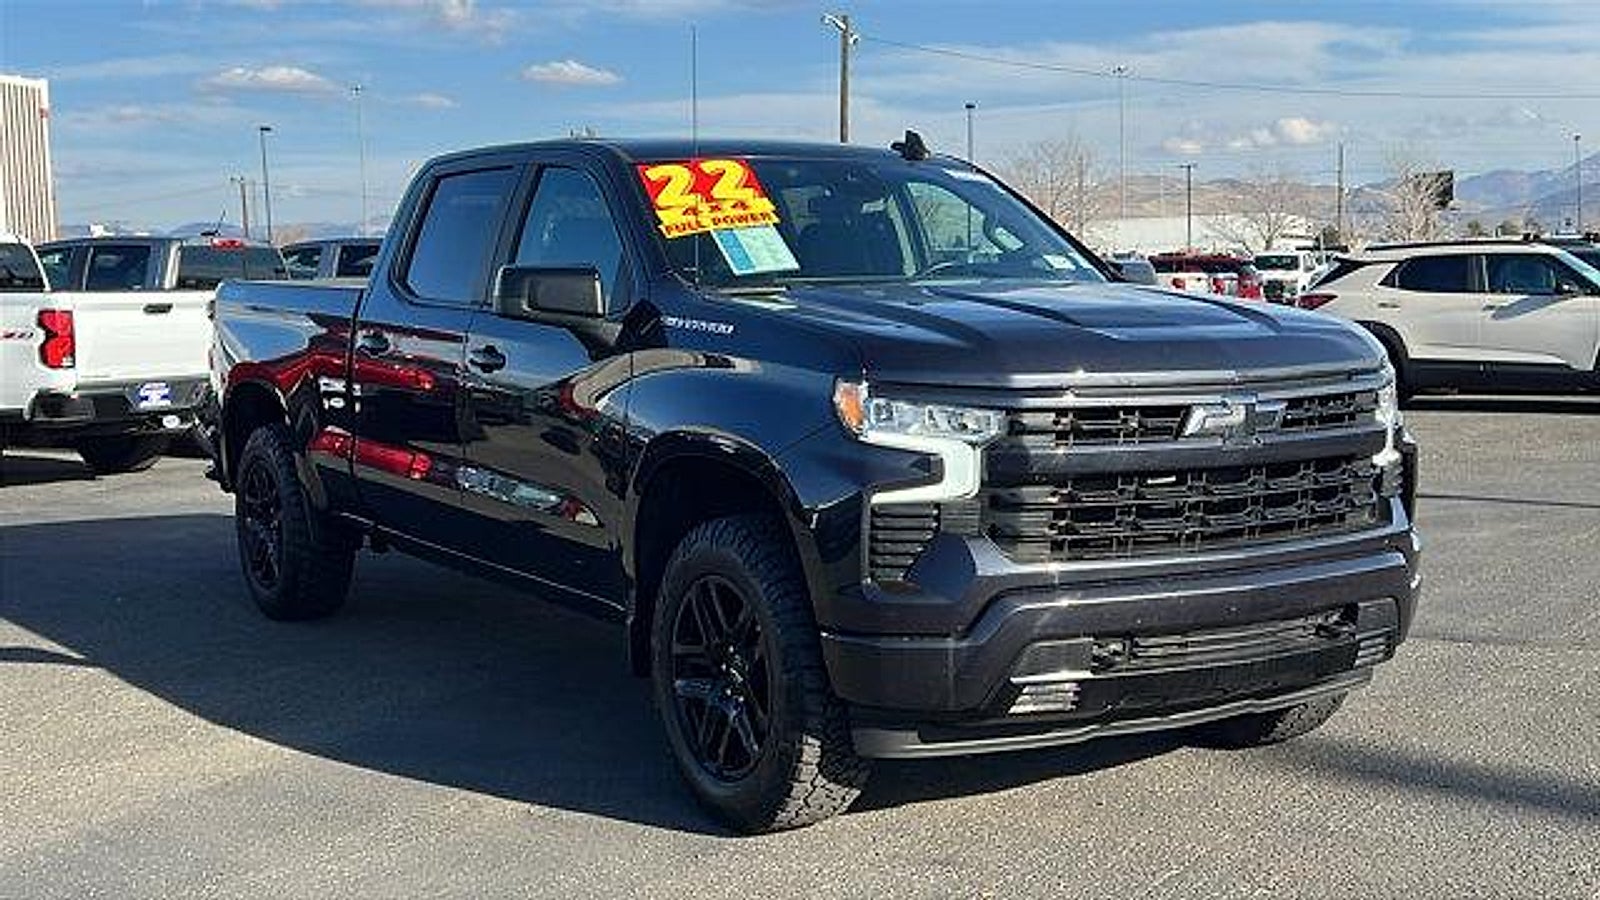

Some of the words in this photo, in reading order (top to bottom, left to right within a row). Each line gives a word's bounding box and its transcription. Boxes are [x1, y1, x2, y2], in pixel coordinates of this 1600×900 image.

[645, 160, 755, 208] 22
[664, 220, 706, 236] FULL
[711, 211, 774, 226] POWER
